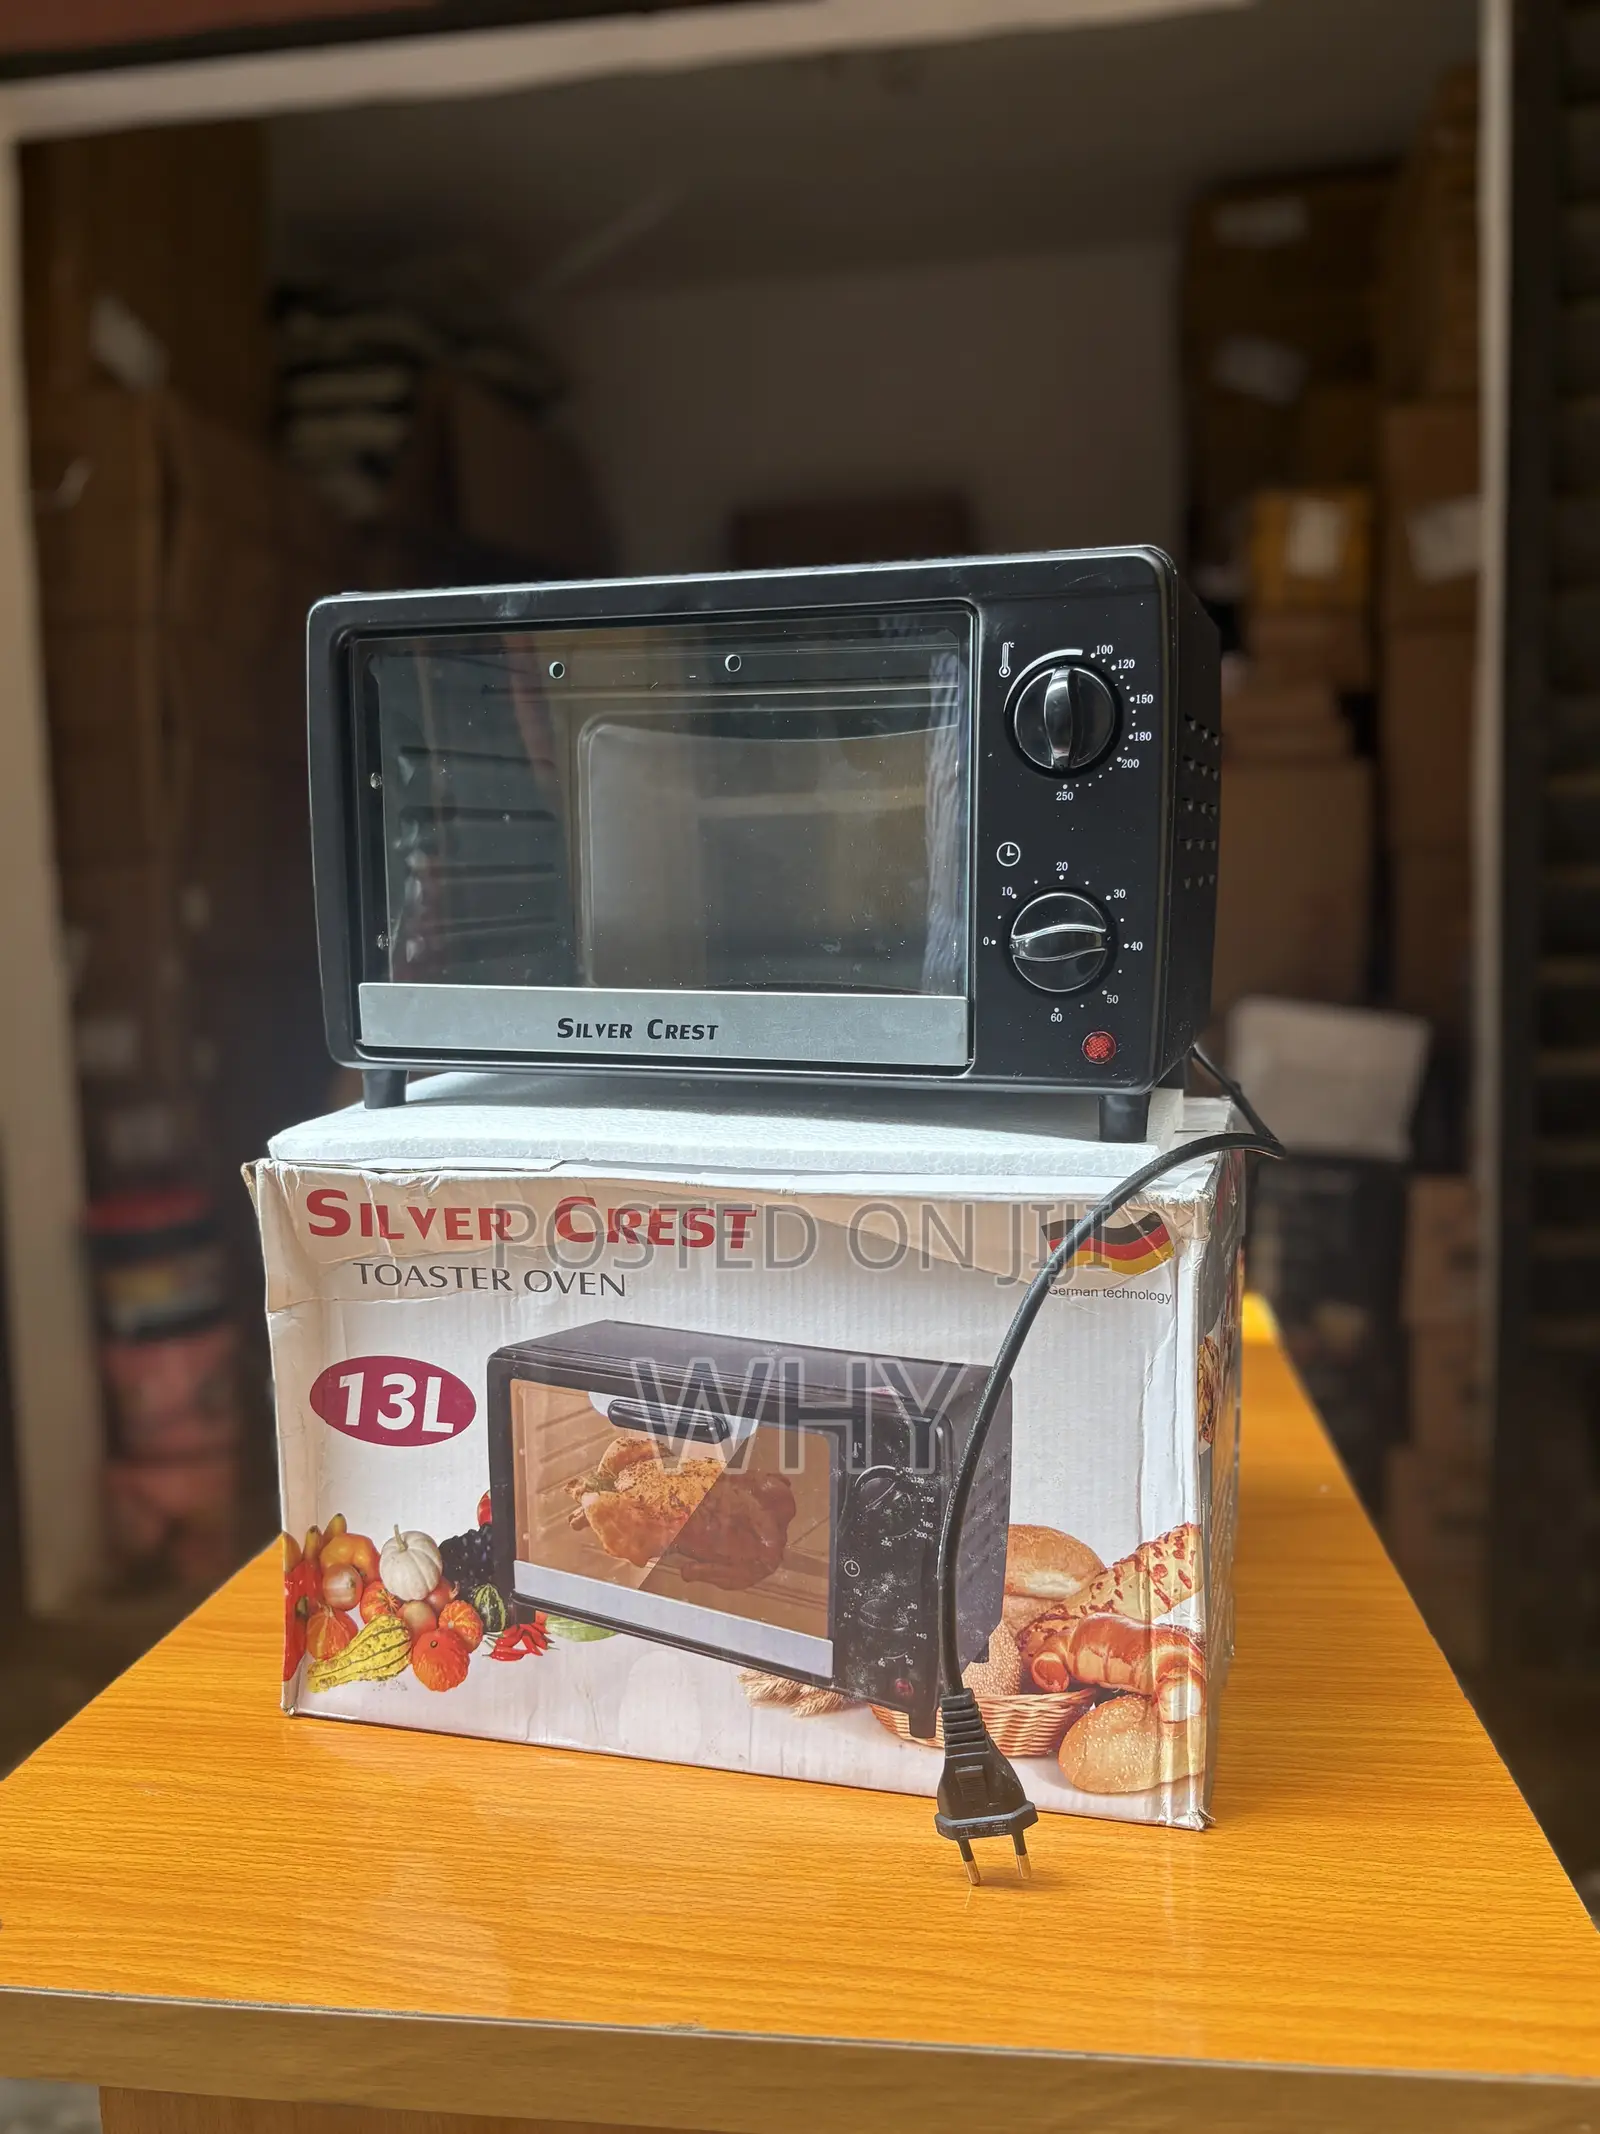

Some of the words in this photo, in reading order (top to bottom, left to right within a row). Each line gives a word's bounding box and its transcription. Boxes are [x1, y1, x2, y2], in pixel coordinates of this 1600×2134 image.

[1096, 645, 1114, 655] 100
[1118, 659, 1135, 669] 120
[1135, 694, 1153, 704] 150
[1134, 732, 1152, 741] 180
[1121, 759, 1140, 768] 200
[1056, 791, 1074, 801] 250
[1056, 862, 1068, 871] 20
[1001, 887, 1013, 896] 10
[1113, 889, 1126, 899] 30
[983, 937, 989, 946] 0
[1130, 941, 1143, 951] 40
[1106, 995, 1119, 1004] 50
[1050, 1013, 1063, 1022] 60
[557, 1017, 633, 1039] SILVER
[647, 1019, 719, 1040] CREST
[306, 1188, 513, 1242] SILVER
[555, 1196, 758, 1249] CREST
[353, 1262, 513, 1292] TOASTER
[524, 1268, 626, 1298] OVEN
[1049, 1285, 1099, 1297] German
[1103, 1288, 1172, 1304] technology
[337, 1371, 457, 1434] 13L
